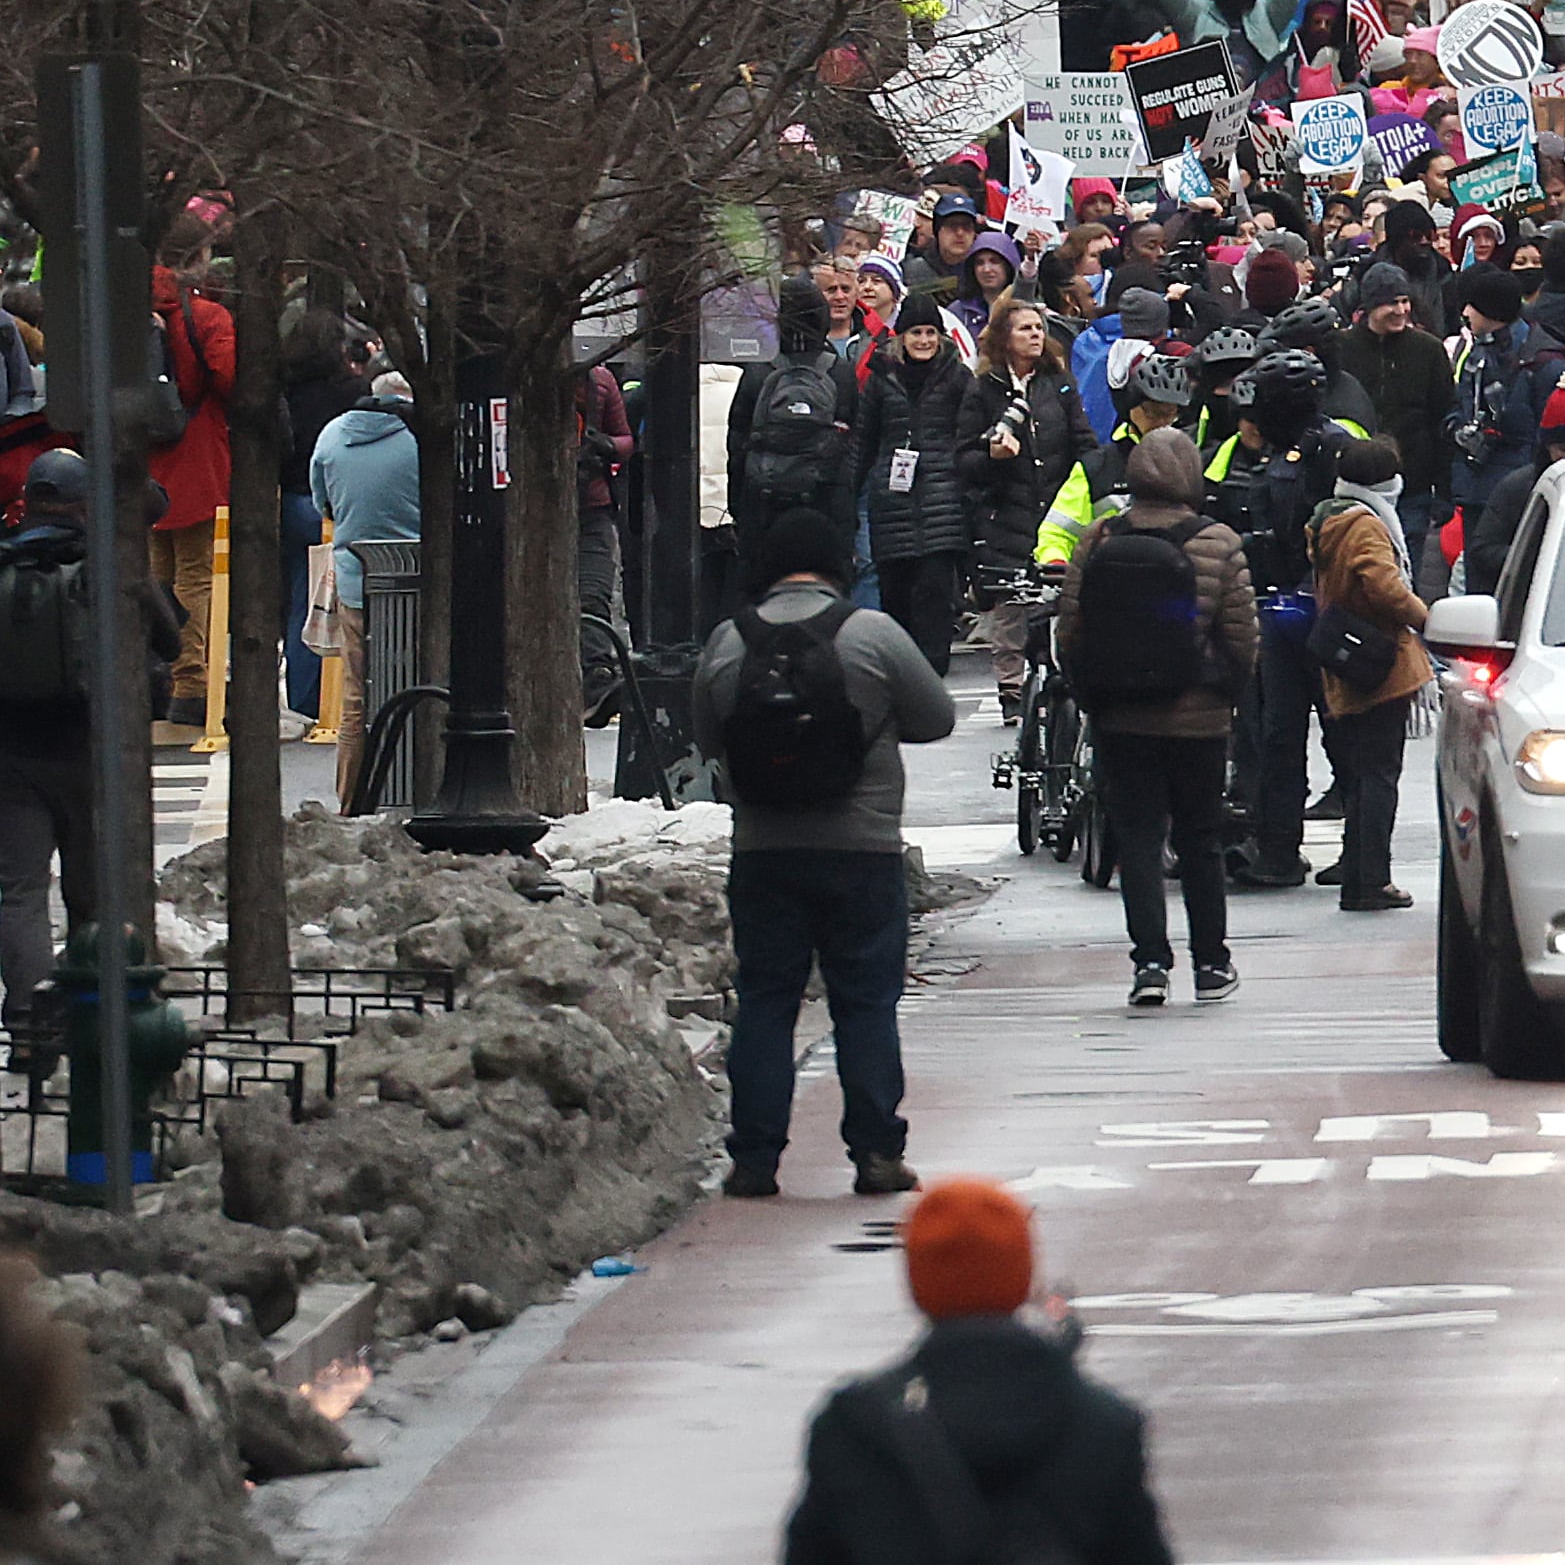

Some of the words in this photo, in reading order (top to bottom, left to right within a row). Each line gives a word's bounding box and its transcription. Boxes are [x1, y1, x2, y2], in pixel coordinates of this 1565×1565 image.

[1046, 77, 1060, 88] WE
[1072, 77, 1118, 88] CANNOT
[1141, 83, 1194, 110] REGULATE
[1196, 74, 1227, 94] GUNS
[1071, 94, 1123, 106] SUCCEED
[1174, 90, 1230, 120] WOMEN
[1474, 88, 1514, 108] KEEP
[1059, 112, 1091, 123] WHEN
[1099, 112, 1121, 123] HAL
[1309, 103, 1349, 122] KEEP
[1467, 103, 1527, 125] ABORTION
[1065, 129, 1081, 140] OF
[1086, 130, 1102, 140] US
[1302, 117, 1361, 142] ABORTION
[1474, 122, 1525, 144] LEGAL
[1062, 147, 1093, 159] HELD
[1100, 147, 1129, 159] BACK
[1308, 136, 1358, 159] LEGAL
[1456, 160, 1518, 187] PEOPL
